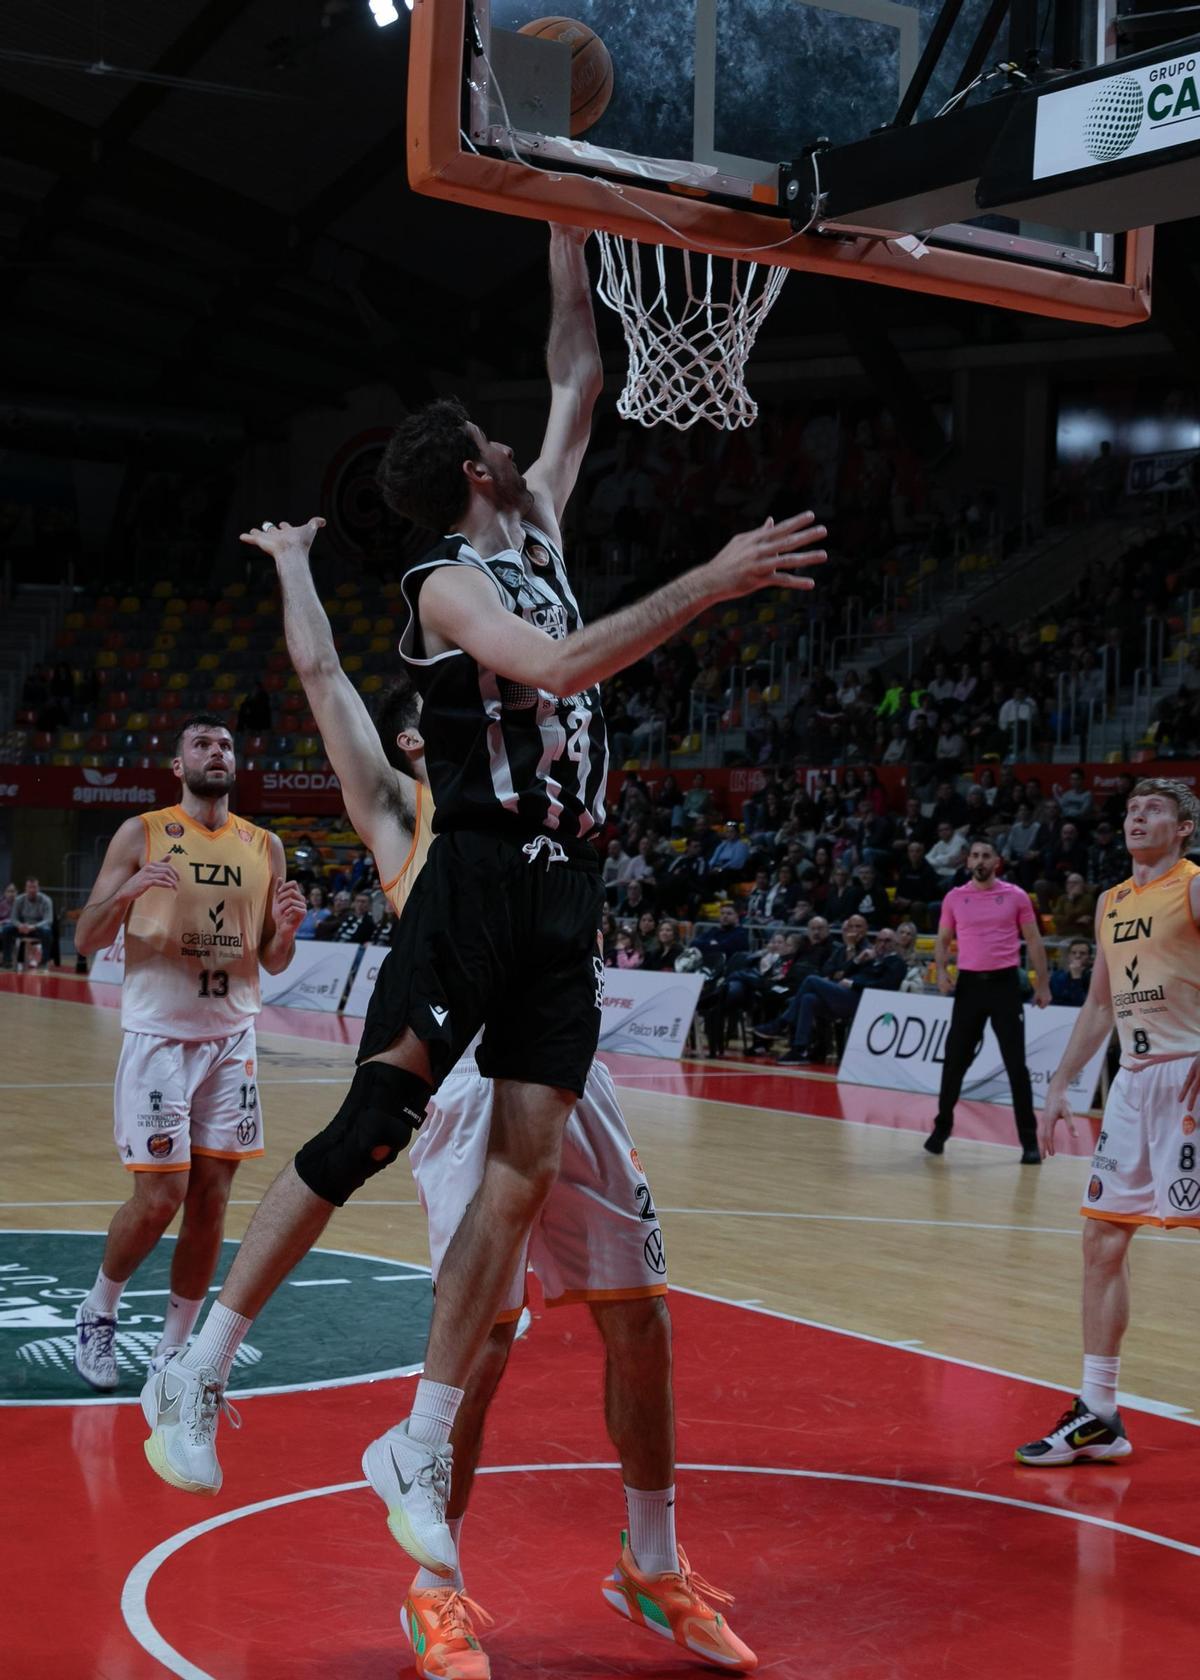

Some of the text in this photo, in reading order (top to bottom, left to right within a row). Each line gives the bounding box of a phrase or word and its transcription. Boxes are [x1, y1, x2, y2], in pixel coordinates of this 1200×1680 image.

[1149, 59, 1196, 82] GRUPO
[1147, 76, 1200, 121] CA
[189, 862, 242, 887] TZN
[181, 930, 243, 949] cajarural
[1113, 917, 1152, 943] TZN
[198, 969, 229, 998] 13
[866, 1013, 982, 1063] ODIL
[1134, 1029, 1150, 1054] 8
[1180, 1144, 1195, 1171] 8
